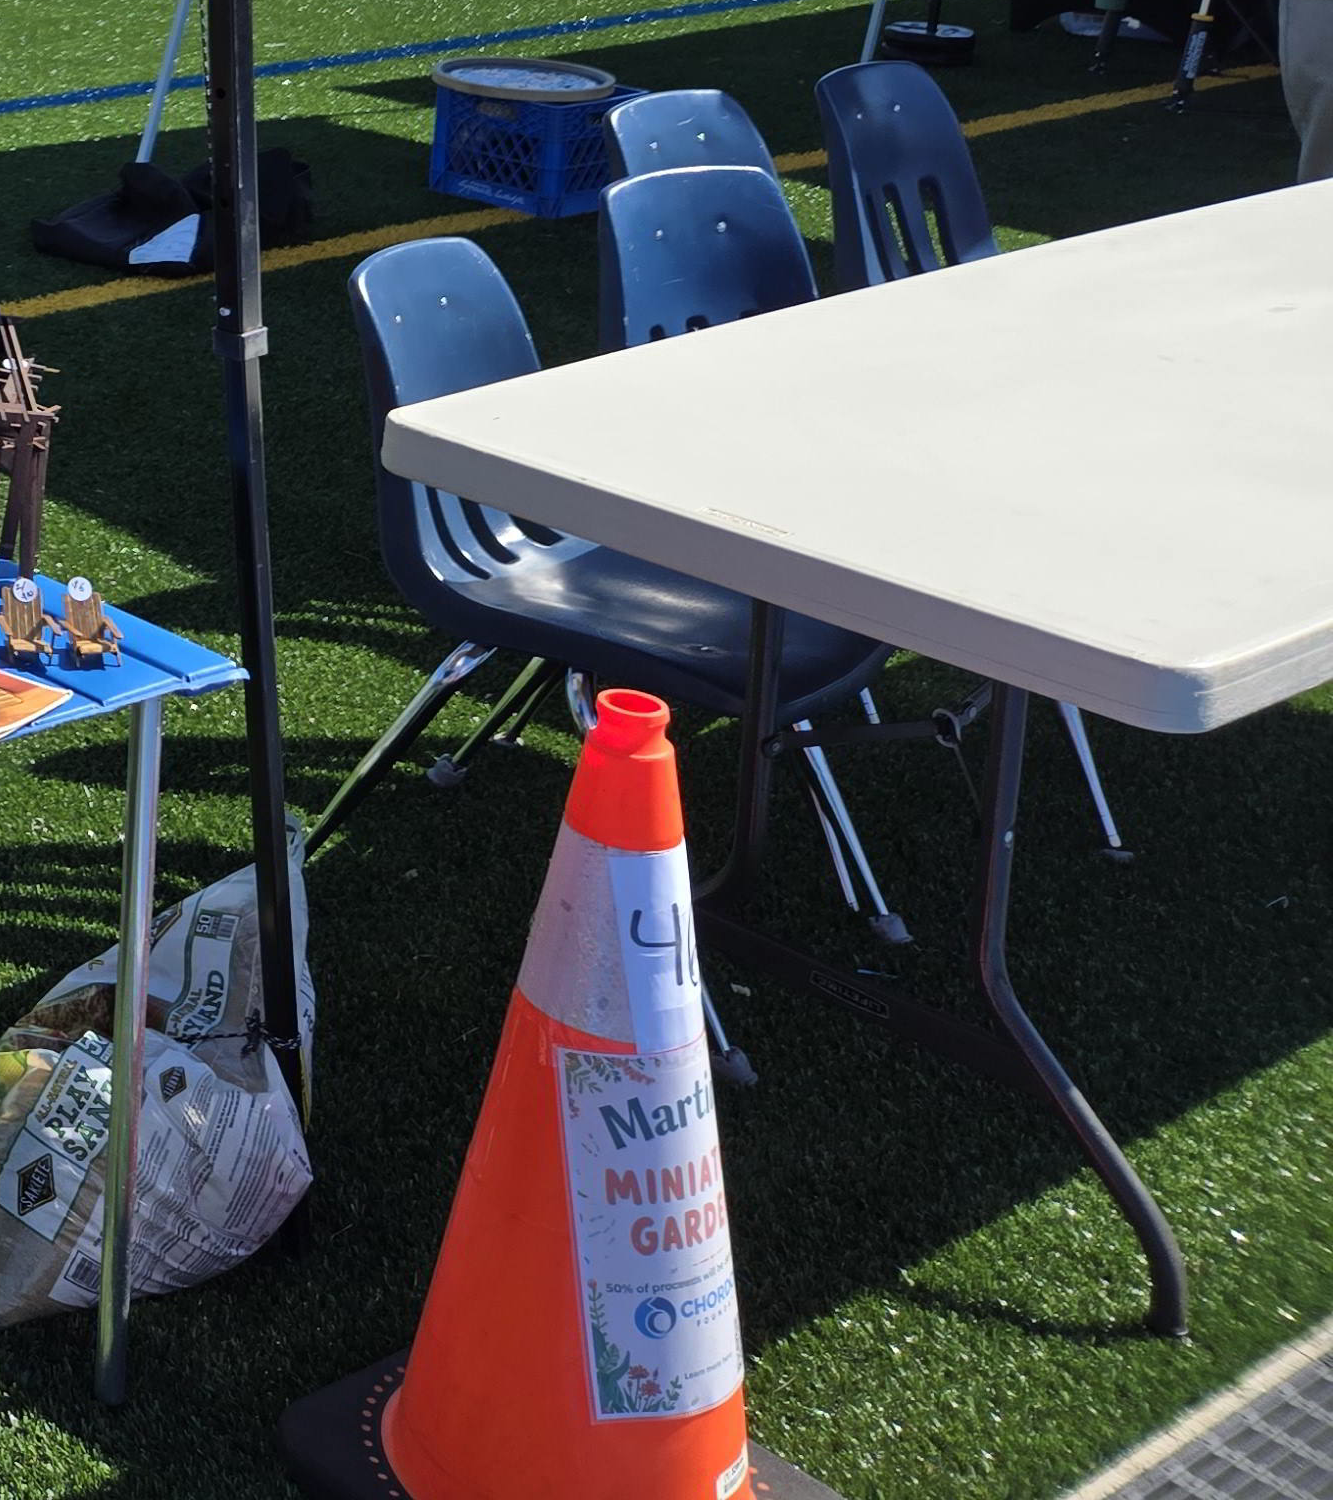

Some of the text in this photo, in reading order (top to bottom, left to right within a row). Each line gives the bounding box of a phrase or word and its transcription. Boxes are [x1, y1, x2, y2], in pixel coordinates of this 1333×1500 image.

[195, 912, 212, 934] 50
[44, 1065, 99, 1140] PLAY
[605, 1282, 633, 1295] 50%
[636, 1282, 649, 1295] of
[652, 1276, 702, 1296] proceeds
